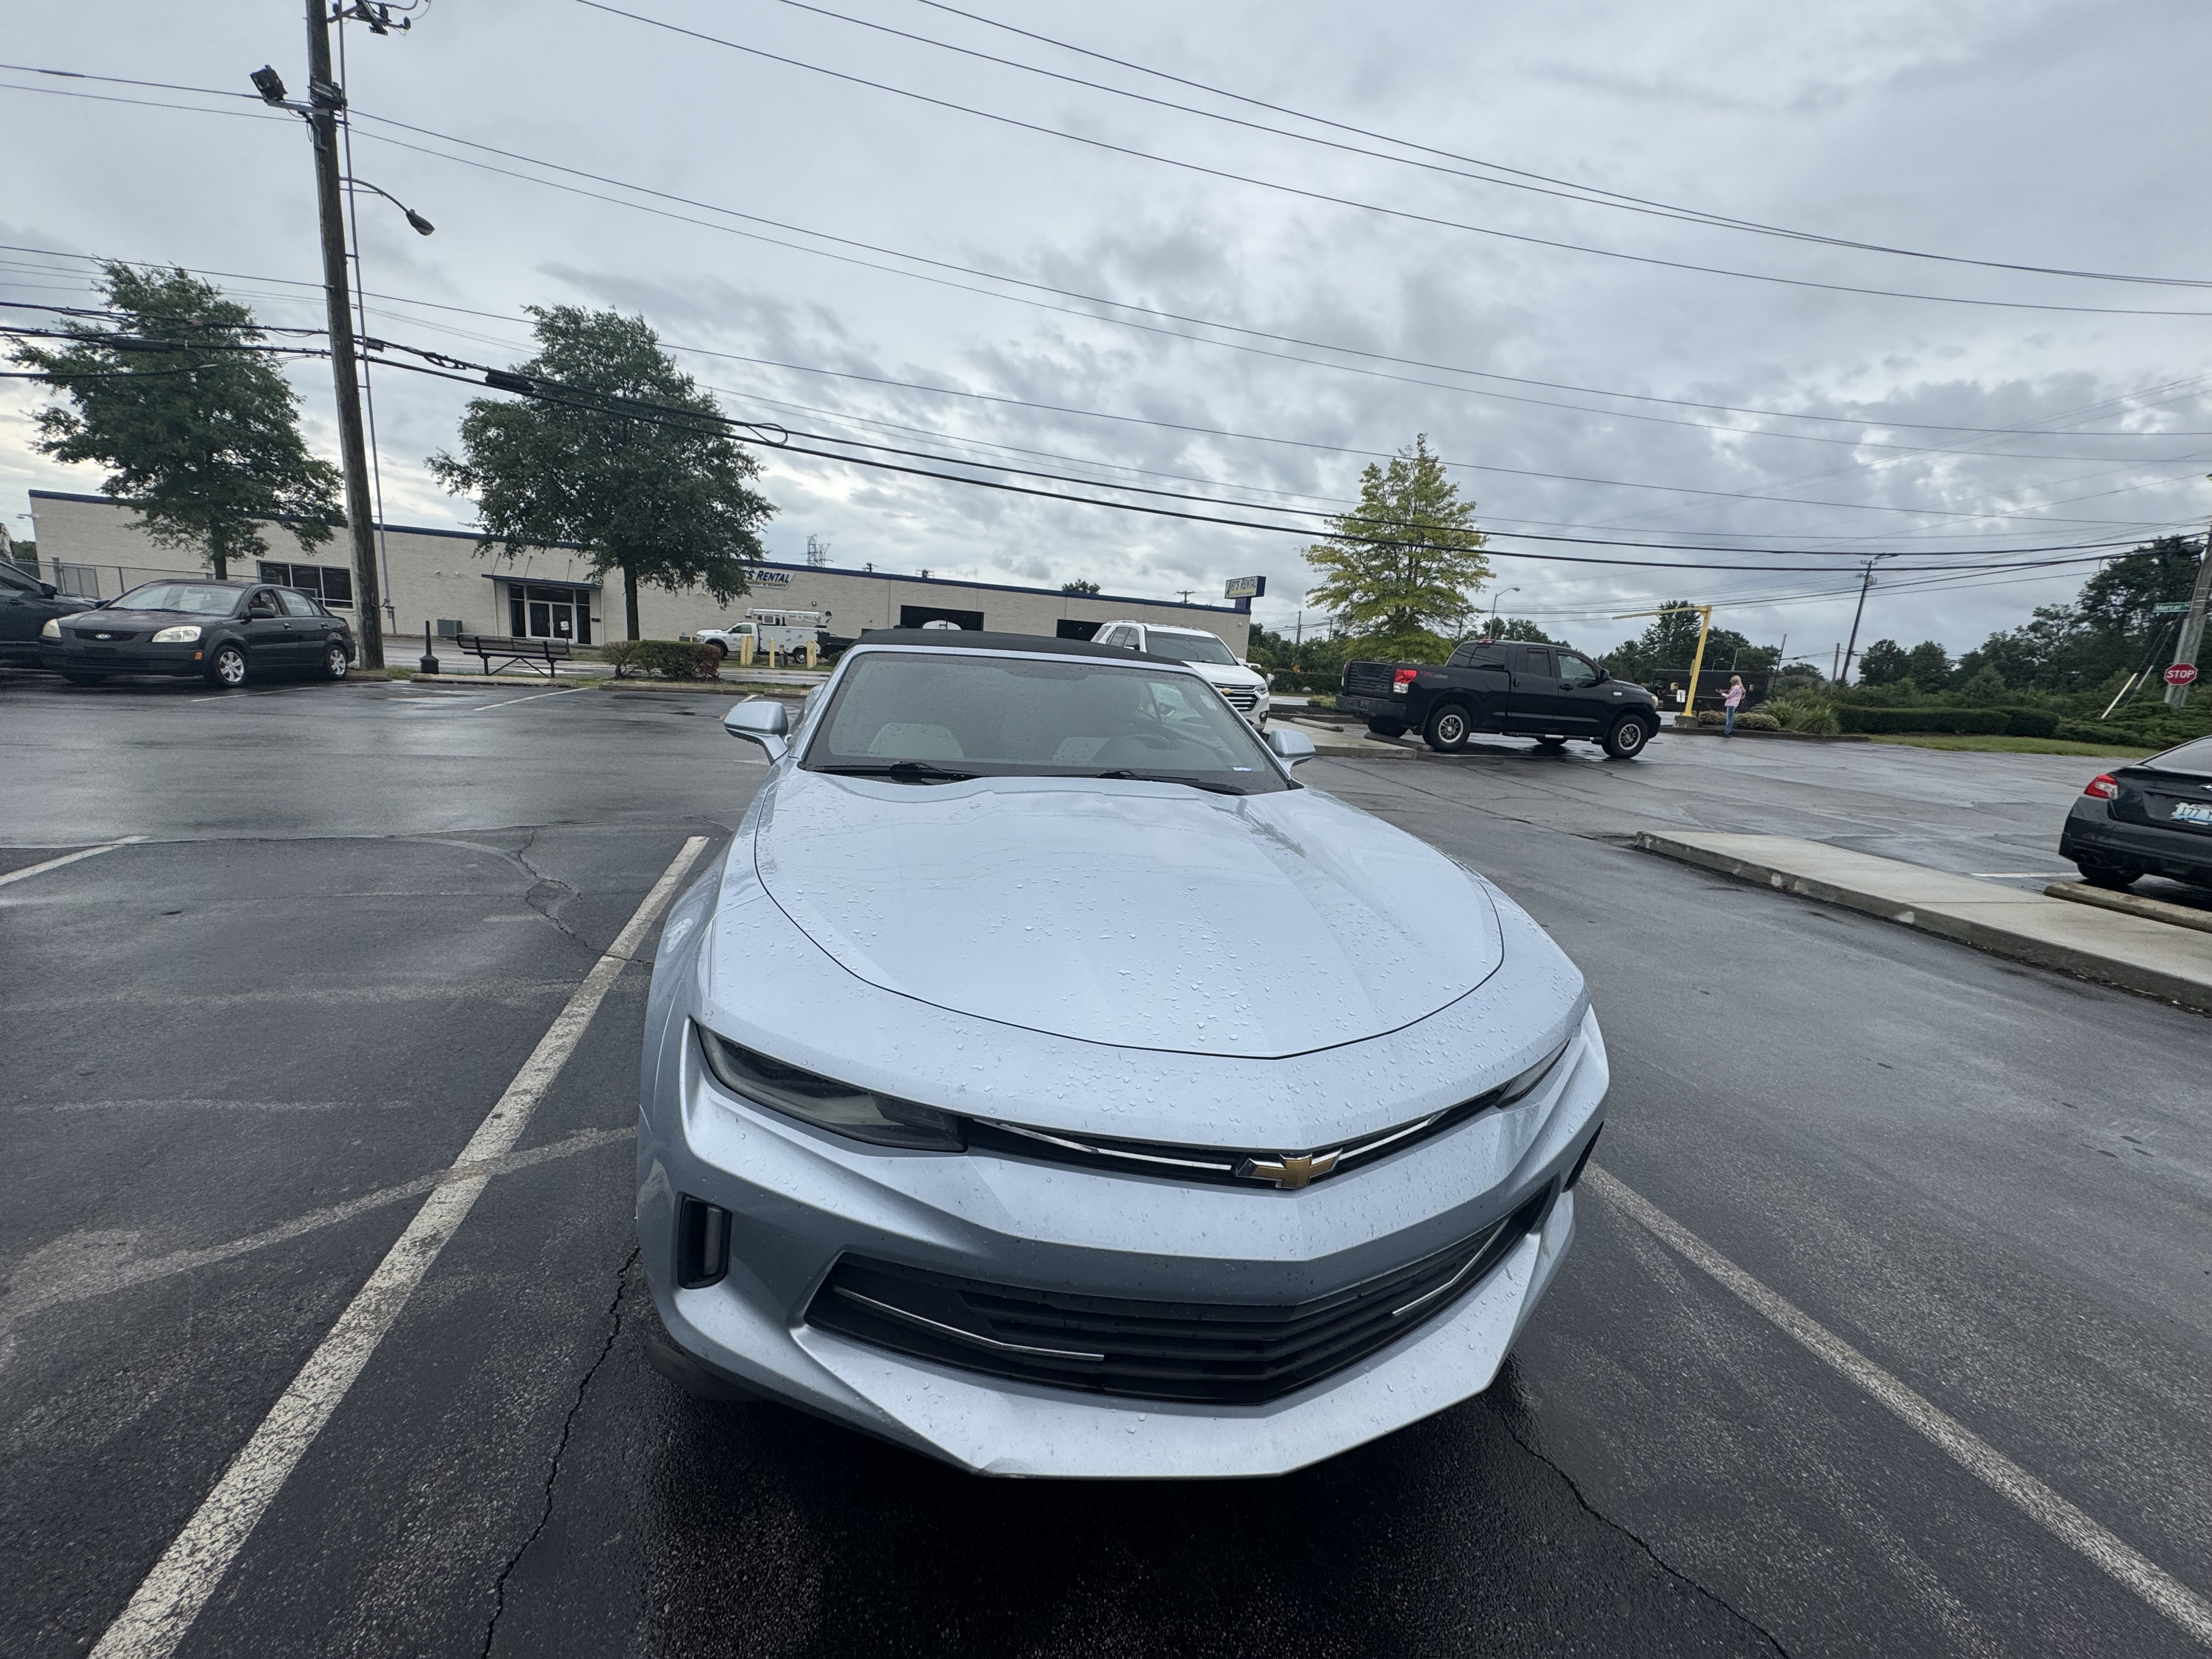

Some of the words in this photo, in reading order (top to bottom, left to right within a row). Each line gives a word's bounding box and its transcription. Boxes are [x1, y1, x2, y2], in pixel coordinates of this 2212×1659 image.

[756, 571, 789, 583] RENTAL
[2166, 670, 2194, 678] STOP
[2179, 807, 2200, 817] 177
